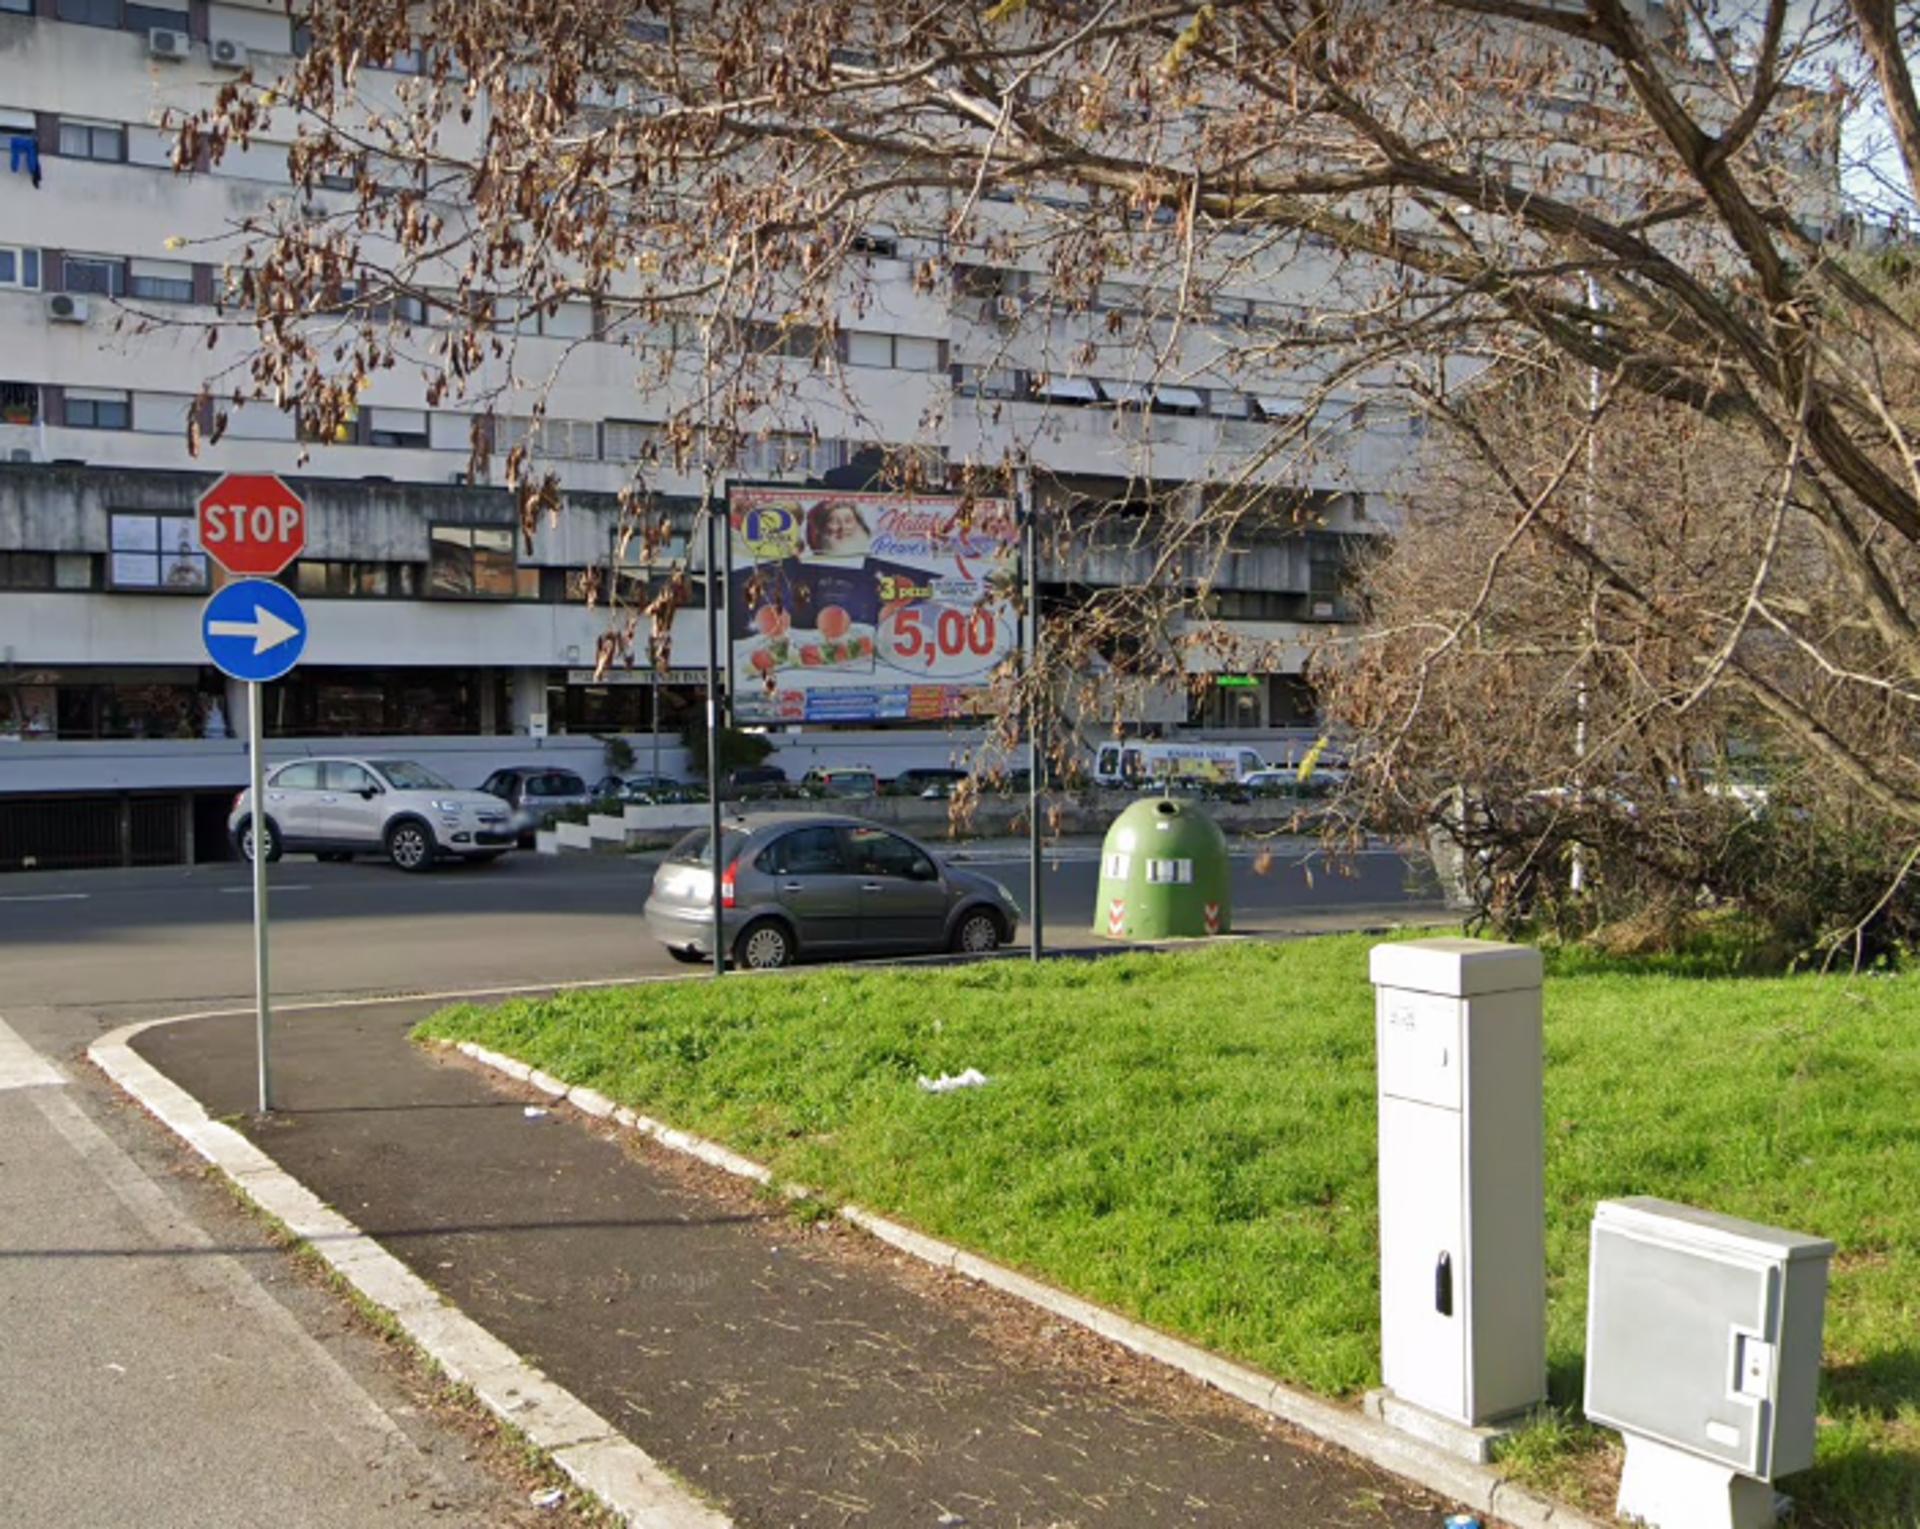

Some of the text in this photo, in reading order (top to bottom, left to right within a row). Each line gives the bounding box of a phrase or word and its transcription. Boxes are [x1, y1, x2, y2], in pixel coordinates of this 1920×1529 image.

[205, 504, 299, 543] STOP
[880, 577, 896, 600] 3
[893, 608, 995, 668] 5,00
